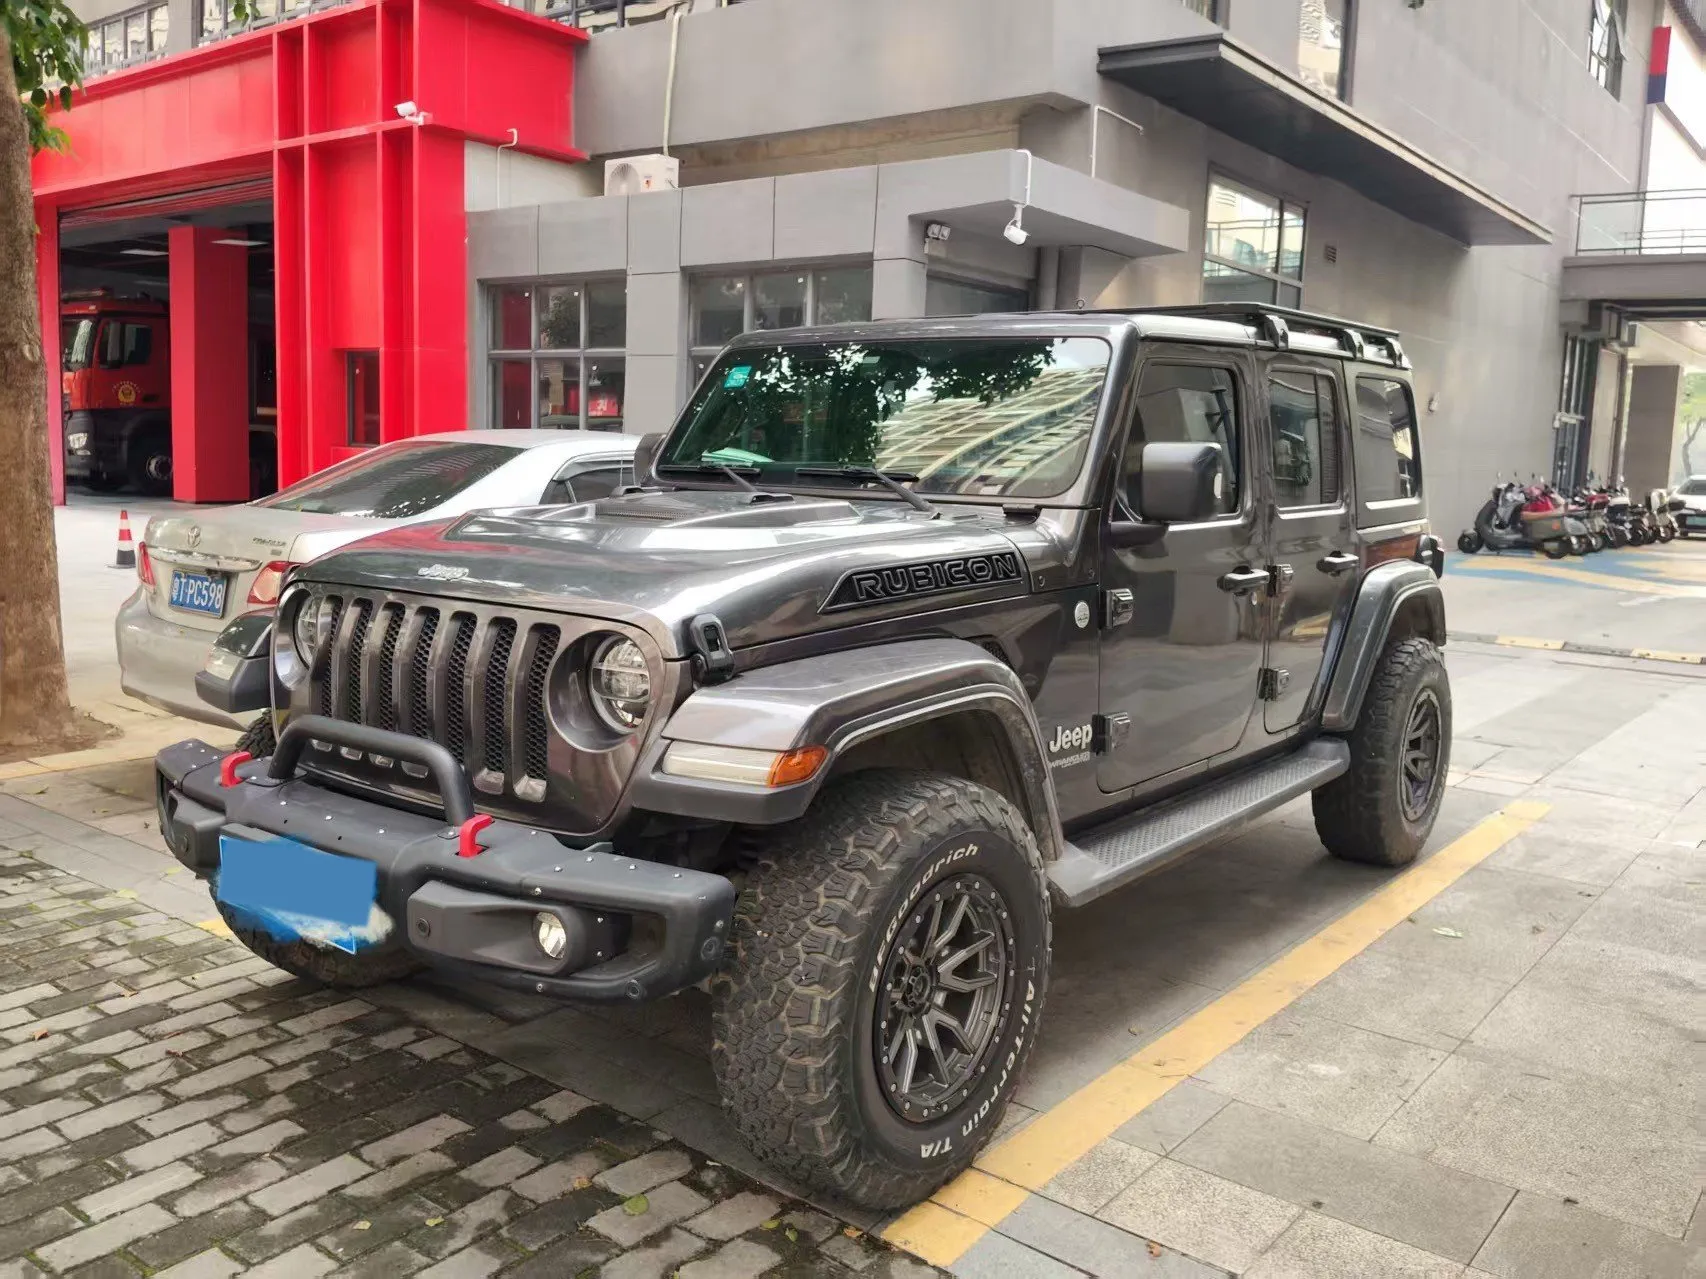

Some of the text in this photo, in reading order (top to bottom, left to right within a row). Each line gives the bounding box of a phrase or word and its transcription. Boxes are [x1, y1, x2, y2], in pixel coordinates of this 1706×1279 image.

[851, 553, 1018, 600] RUBICON
[1049, 724, 1093, 753] Jeep
[920, 979, 1035, 1159] All-Terrain T/A
